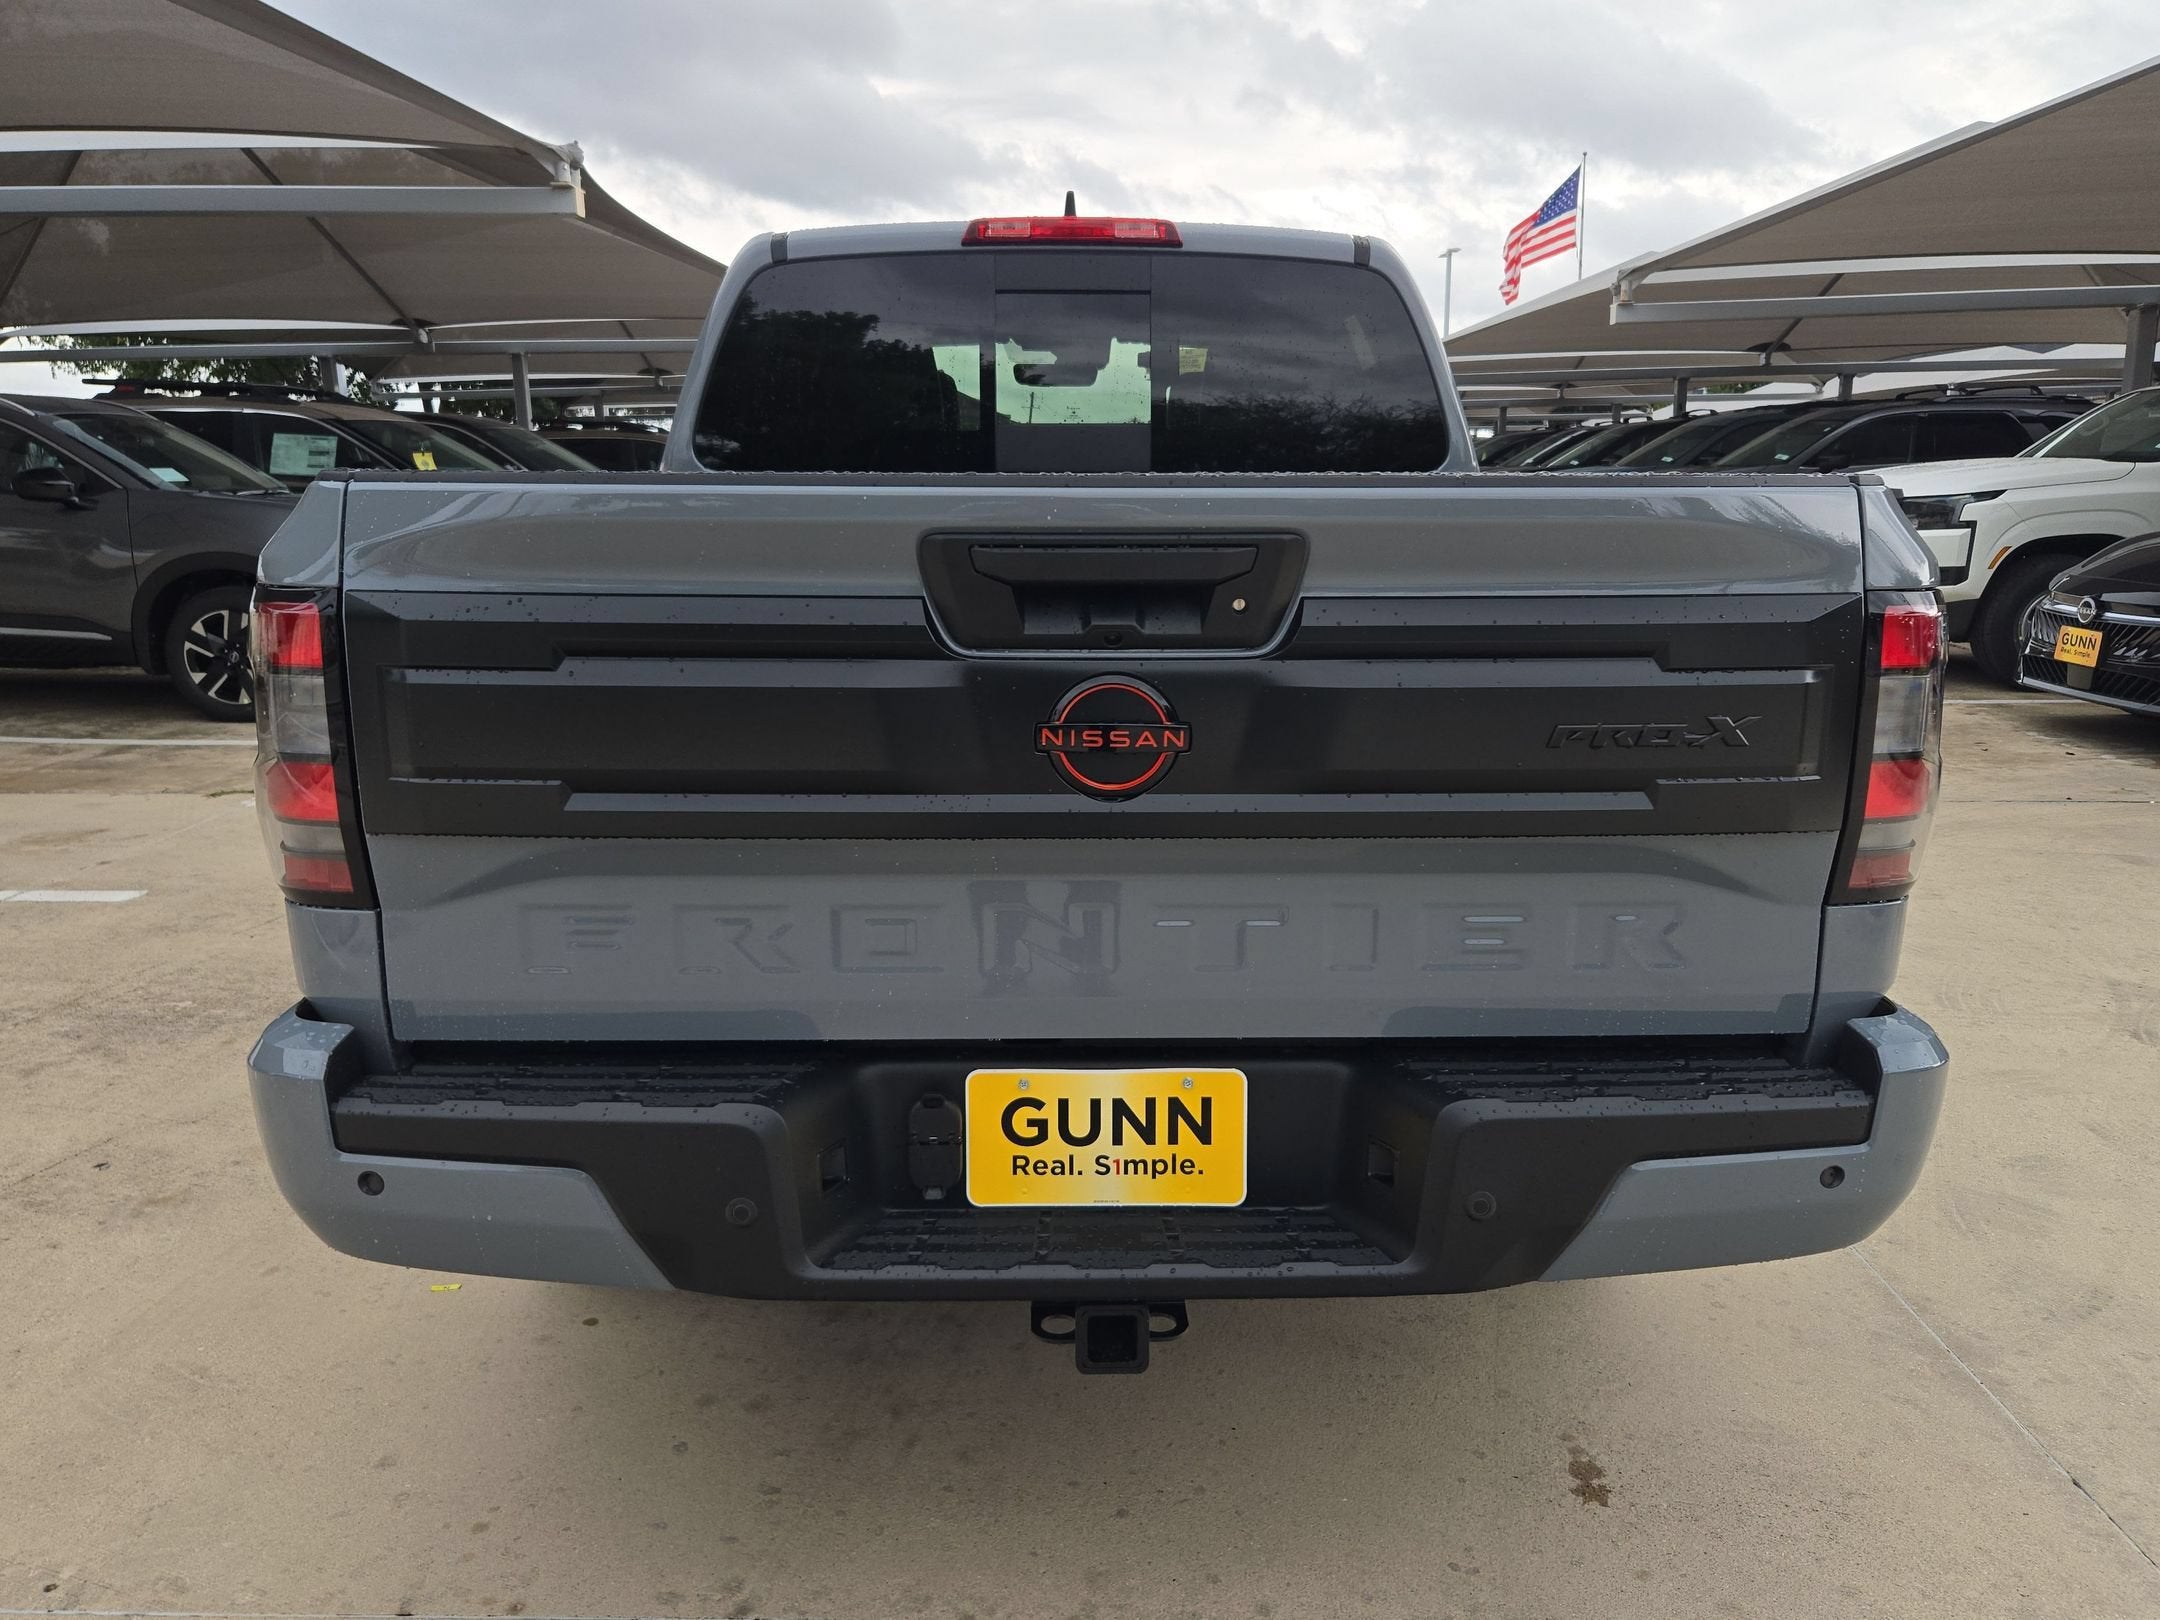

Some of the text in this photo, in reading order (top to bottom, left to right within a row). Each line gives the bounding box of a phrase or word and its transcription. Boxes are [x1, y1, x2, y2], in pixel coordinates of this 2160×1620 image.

[2062, 632, 2097, 651] GUNN
[1041, 728, 1184, 748] NISSAN
[1546, 716, 1762, 749] PRO-X
[519, 903, 1687, 975] FRONTIER
[1001, 1096, 1212, 1147] GUNN
[1012, 1153, 1204, 1180] Real. S1mple.
